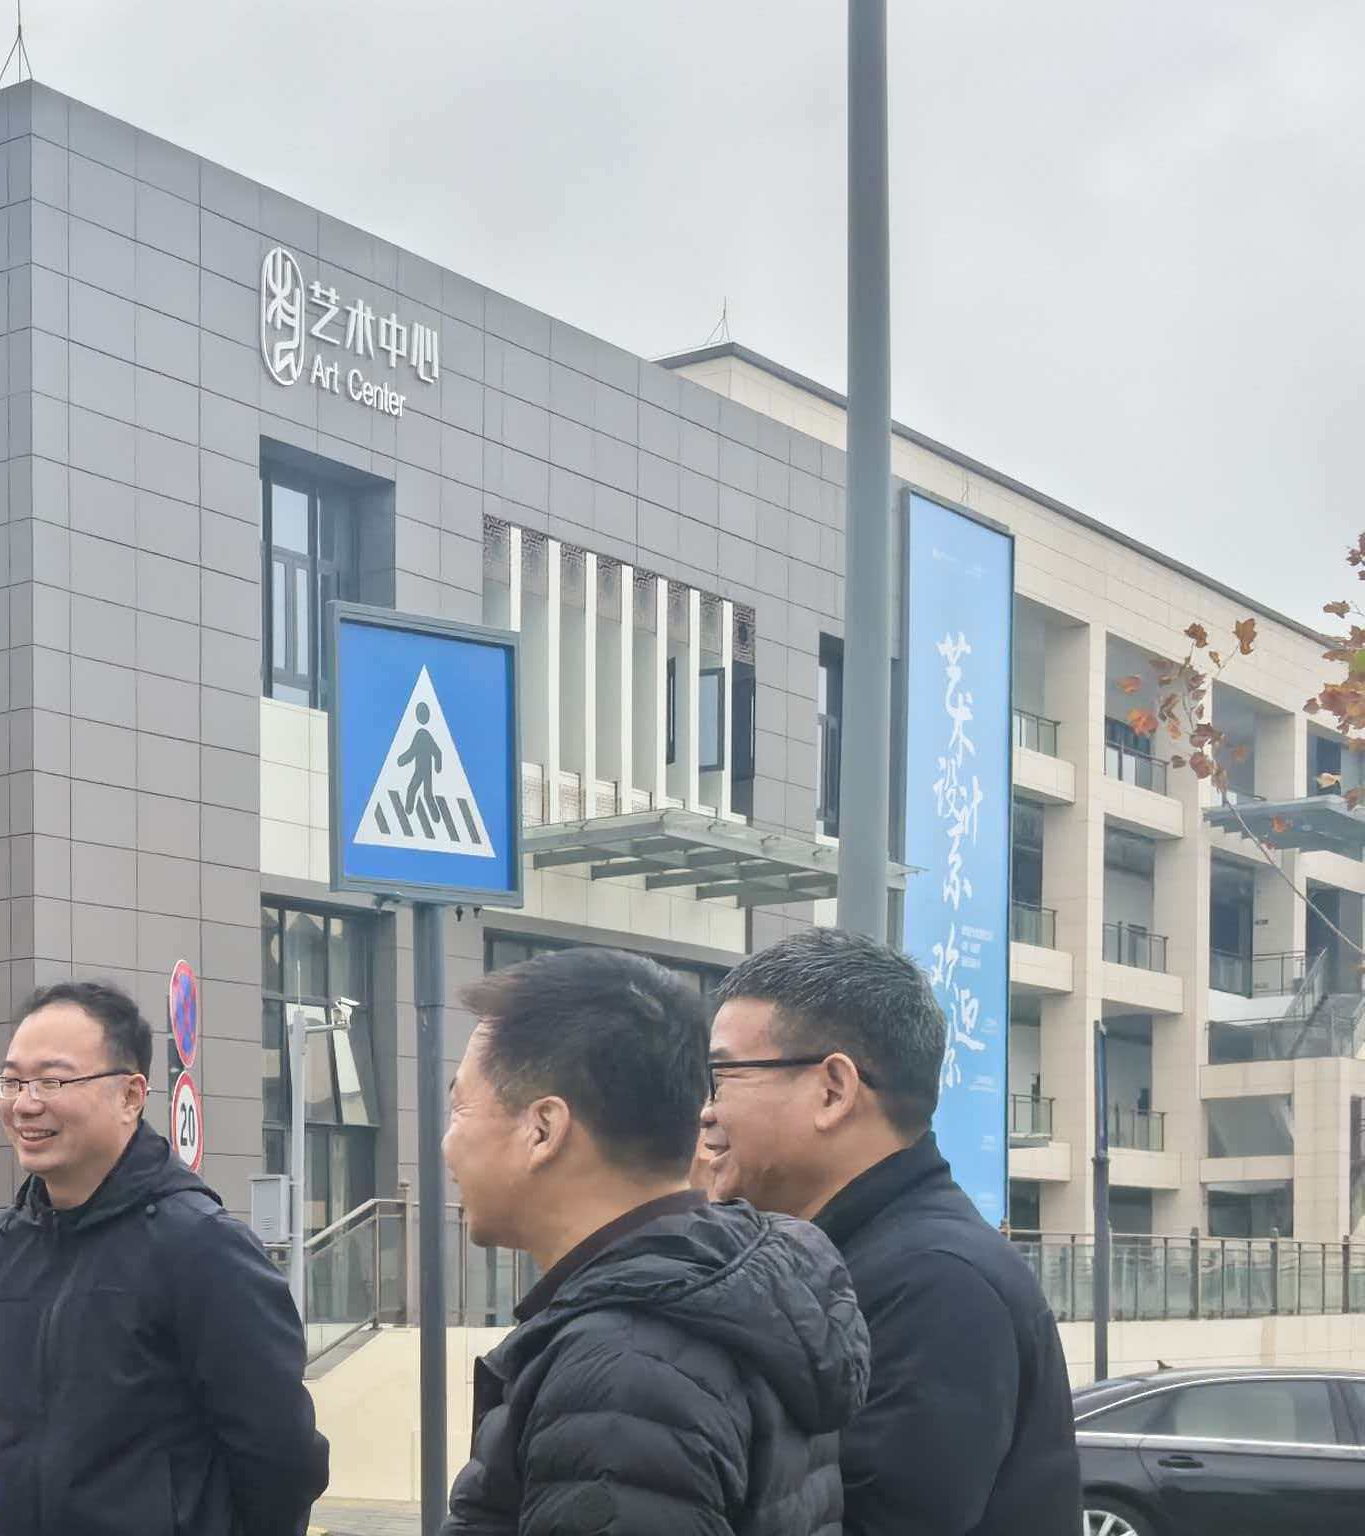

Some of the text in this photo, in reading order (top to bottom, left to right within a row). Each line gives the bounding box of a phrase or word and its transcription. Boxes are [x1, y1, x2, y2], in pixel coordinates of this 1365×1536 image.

[309, 280, 439, 384] 艺术中心
[310, 354, 407, 417] Art Center
[180, 1101, 196, 1147] 20
